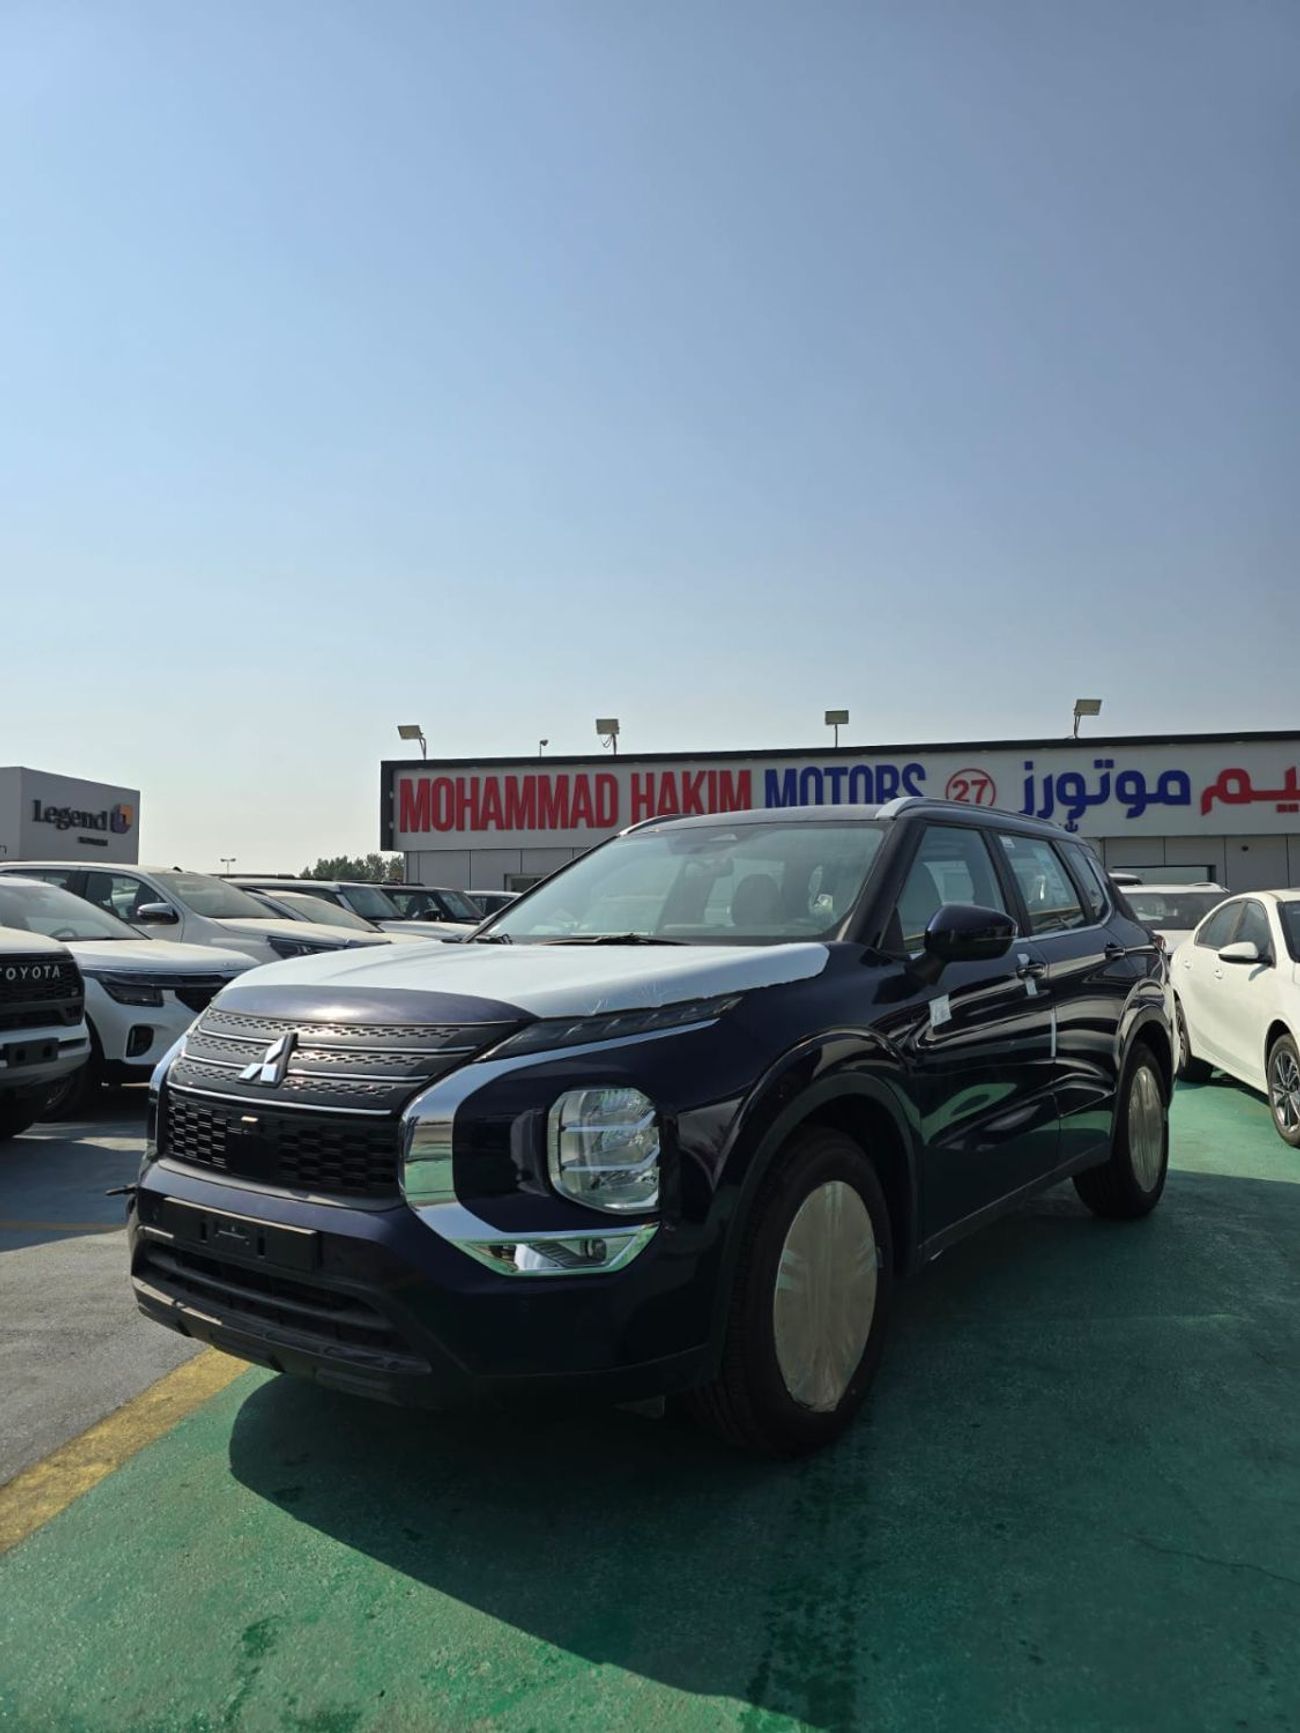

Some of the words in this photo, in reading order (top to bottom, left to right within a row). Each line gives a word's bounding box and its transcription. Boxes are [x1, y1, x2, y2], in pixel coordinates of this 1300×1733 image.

[399, 772, 620, 833] MOHAMMAD
[630, 768, 752, 826] HAKIM
[764, 762, 927, 809] MOTORS
[952, 778, 989, 805] 27
[1018, 758, 1192, 820] موتورز
[1201, 766, 1300, 817] يم
[32, 799, 108, 831] Legend
[0, 965, 61, 981] OYOTA
